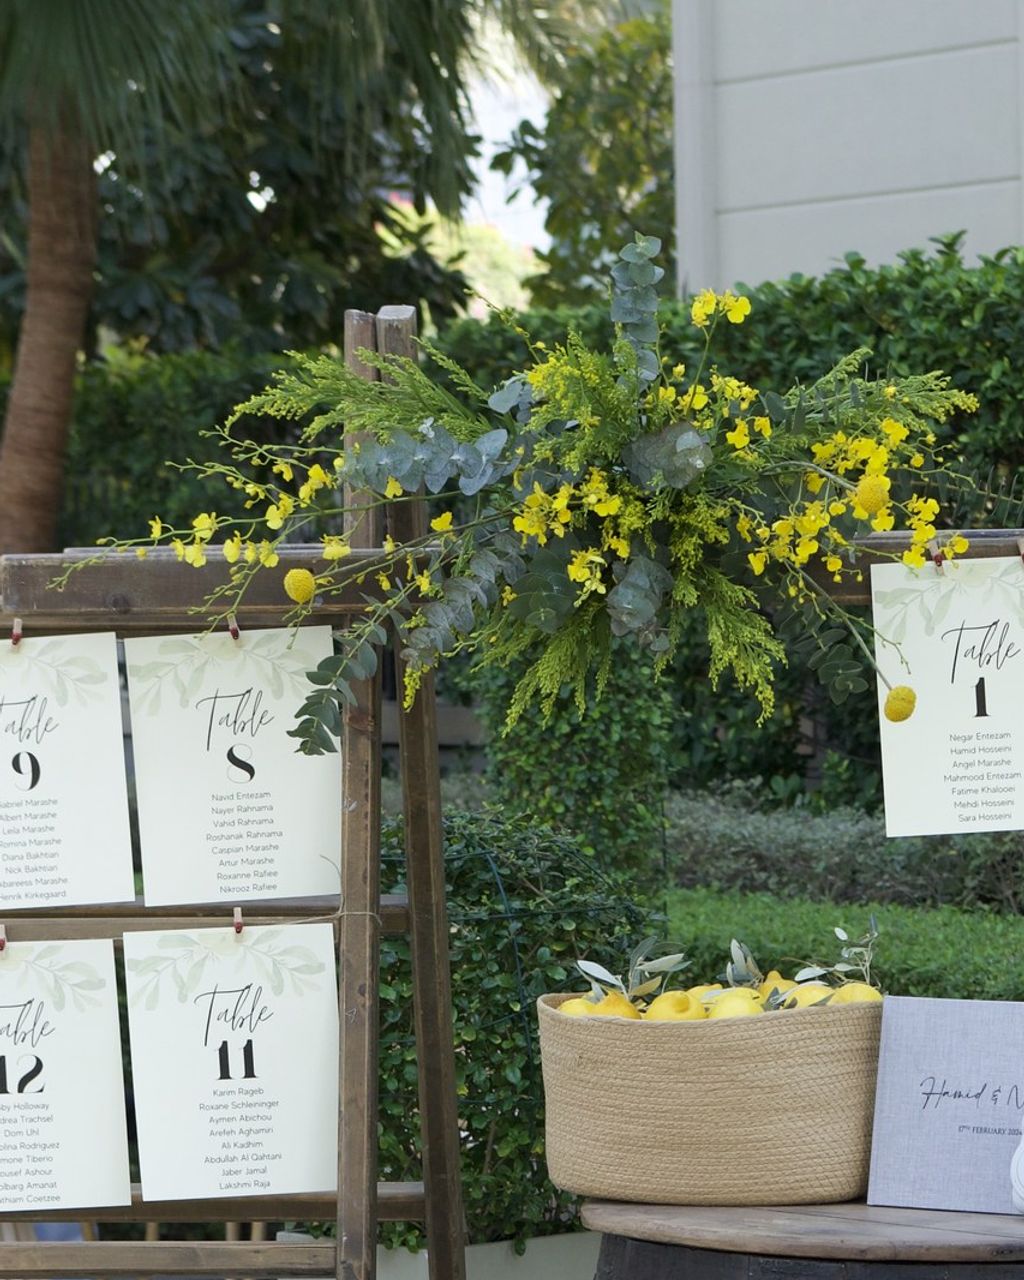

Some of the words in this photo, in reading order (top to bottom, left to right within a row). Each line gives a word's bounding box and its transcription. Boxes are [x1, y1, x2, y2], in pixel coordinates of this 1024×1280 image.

[941, 618, 1021, 684] Table
[971, 677, 991, 718] 1
[196, 687, 275, 752] Table
[949, 734, 973, 743] Negar
[976, 732, 1011, 741] Entezam
[950, 747, 976, 755] Hamid
[226, 743, 256, 784] 8
[952, 760, 976, 770] Angel
[977, 759, 1012, 767] Marashe
[11, 751, 41, 792] 9
[944, 774, 985, 782] Mahmood
[986, 772, 1022, 780] Entezam
[951, 787, 979, 795] Fatime
[211, 793, 234, 801] Navid
[236, 792, 271, 800] Entezam
[25, 798, 58, 807] Marashe
[954, 800, 979, 808] Mehdi
[981, 799, 1015, 807] Hosseini
[211, 807, 234, 816] Nayer
[237, 805, 274, 813] Rahnama
[24, 812, 57, 820] Marashe
[958, 814, 976, 822] Sara
[213, 820, 236, 828] Vahid
[237, 818, 274, 826] Rahnama
[22, 825, 55, 833] Marashe
[206, 833, 243, 841] Roshanak
[29, 838, 62, 847] Marashe
[211, 846, 244, 855] Caspian
[246, 843, 279, 852] Marashe
[1, 853, 24, 861] Diana
[241, 857, 275, 865] Marashe
[5, 866, 23, 874] Nick
[217, 871, 251, 880] Roxanne
[35, 877, 68, 885] Marashe
[194, 983, 275, 1046] Table
[0, 998, 56, 1048] able
[214, 1038, 259, 1080] 11
[213, 1089, 236, 1097] Karim
[238, 1087, 264, 1097] Rageb
[919, 1076, 988, 1110] Hamid
[13, 1102, 49, 1110] Holloway
[199, 1103, 229, 1111] Roxane
[20, 1115, 53, 1123] Trachsel
[209, 1116, 237, 1125] Aymen
[239, 1114, 272, 1122] Abichou
[4, 1129, 24, 1137] Dom
[972, 1126, 1006, 1136] FEBRUARY
[19, 1141, 60, 1151] Rodriguez
[222, 1141, 231, 1149] Ali
[204, 1155, 238, 1164] Abdullah
[0, 1169, 22, 1177] ousef
[25, 1168, 52, 1176] Ashour
[222, 1168, 242, 1176] Jaber
[245, 1165, 267, 1175] Jamal
[0, 1182, 24, 1191] olbarg
[219, 1182, 252, 1190] Lakshmi
[253, 1180, 270, 1189] Raja
